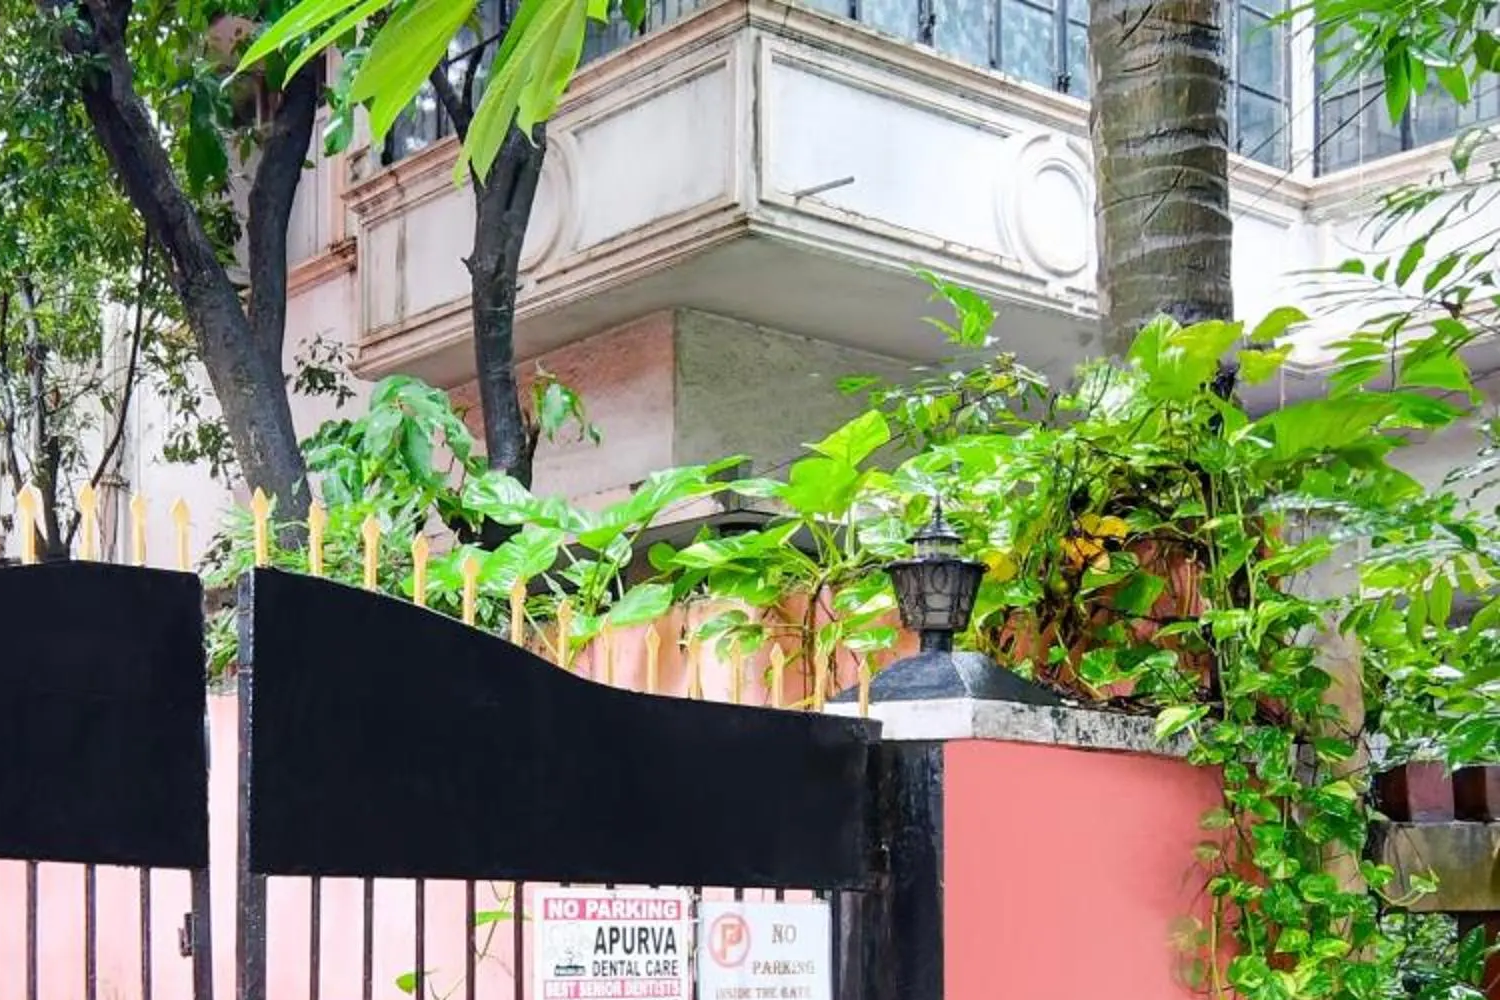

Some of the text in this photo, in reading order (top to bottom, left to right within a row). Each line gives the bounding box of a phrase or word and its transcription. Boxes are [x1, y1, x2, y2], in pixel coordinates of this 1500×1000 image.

[547, 899, 677, 920] NO PARKING
[593, 925, 678, 955] APURVA
[771, 923, 798, 945] NO
[591, 960, 679, 977] DENTAL CARE
[752, 959, 816, 975] PARKING
[755, 986, 778, 1000] THE
